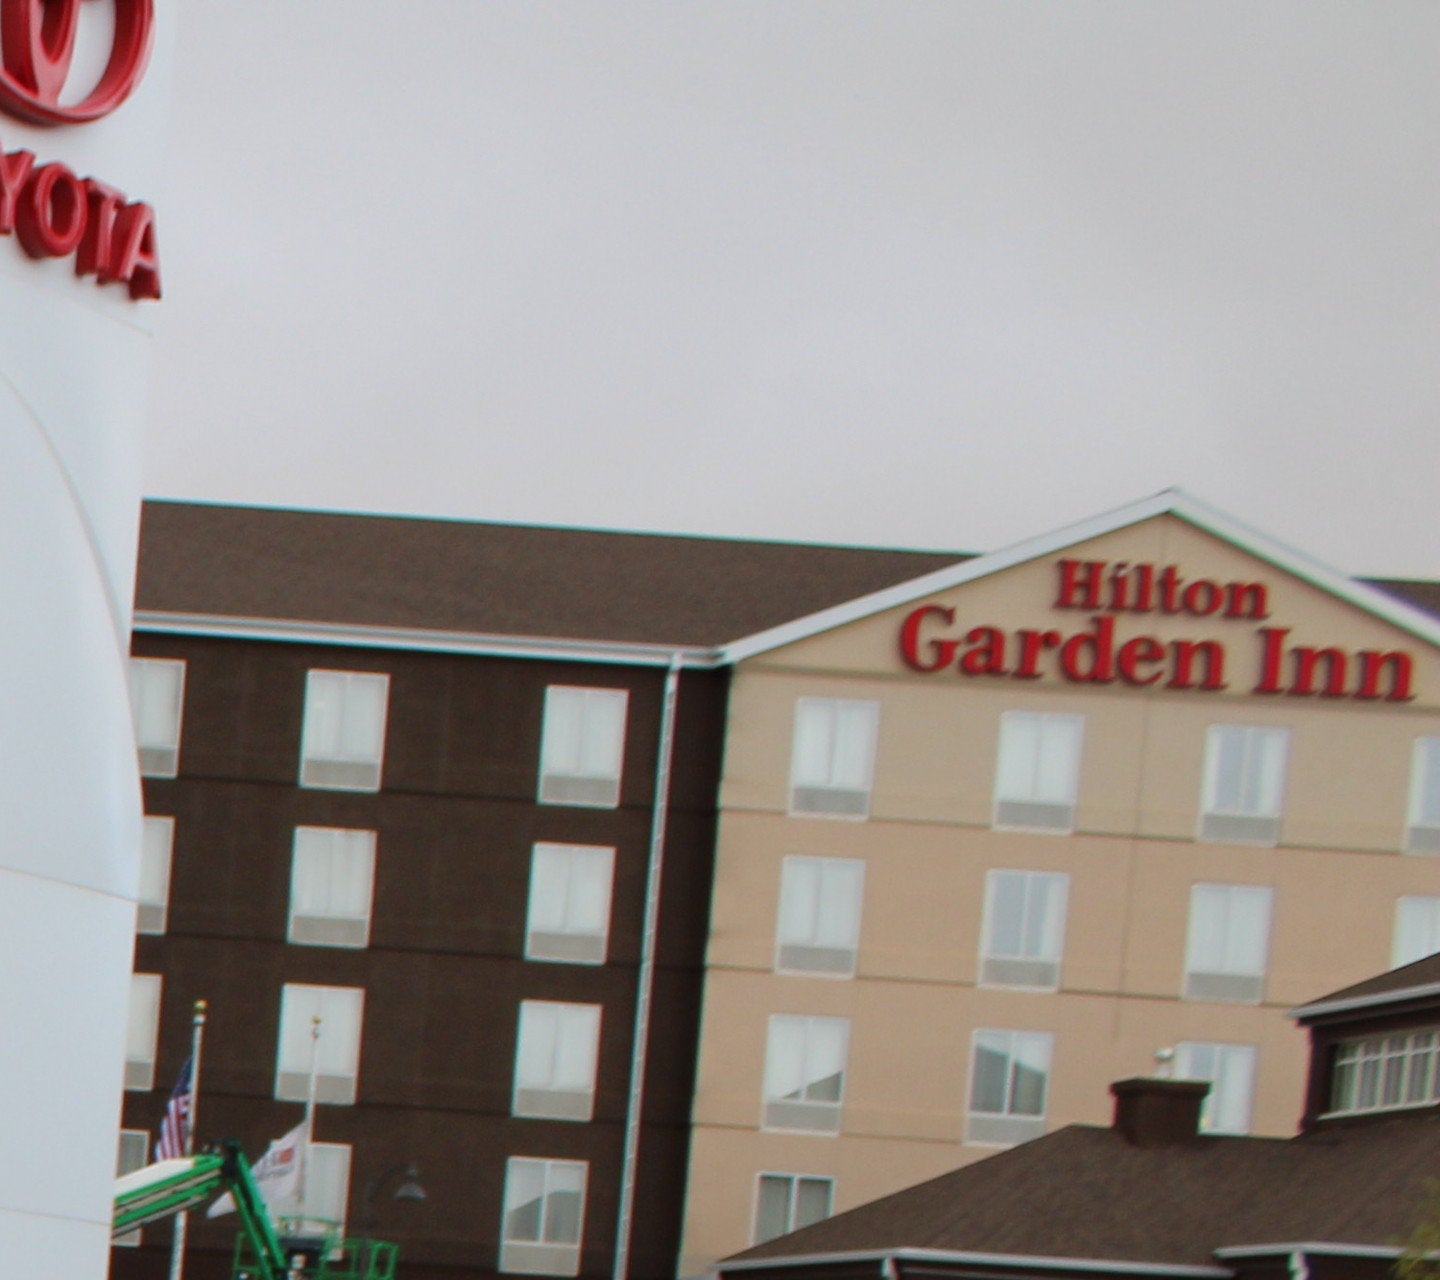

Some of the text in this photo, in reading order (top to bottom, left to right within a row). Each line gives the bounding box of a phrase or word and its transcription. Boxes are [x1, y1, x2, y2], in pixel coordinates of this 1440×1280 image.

[1052, 558, 1270, 620] Hilton
[897, 604, 1417, 702] Garden Inn
